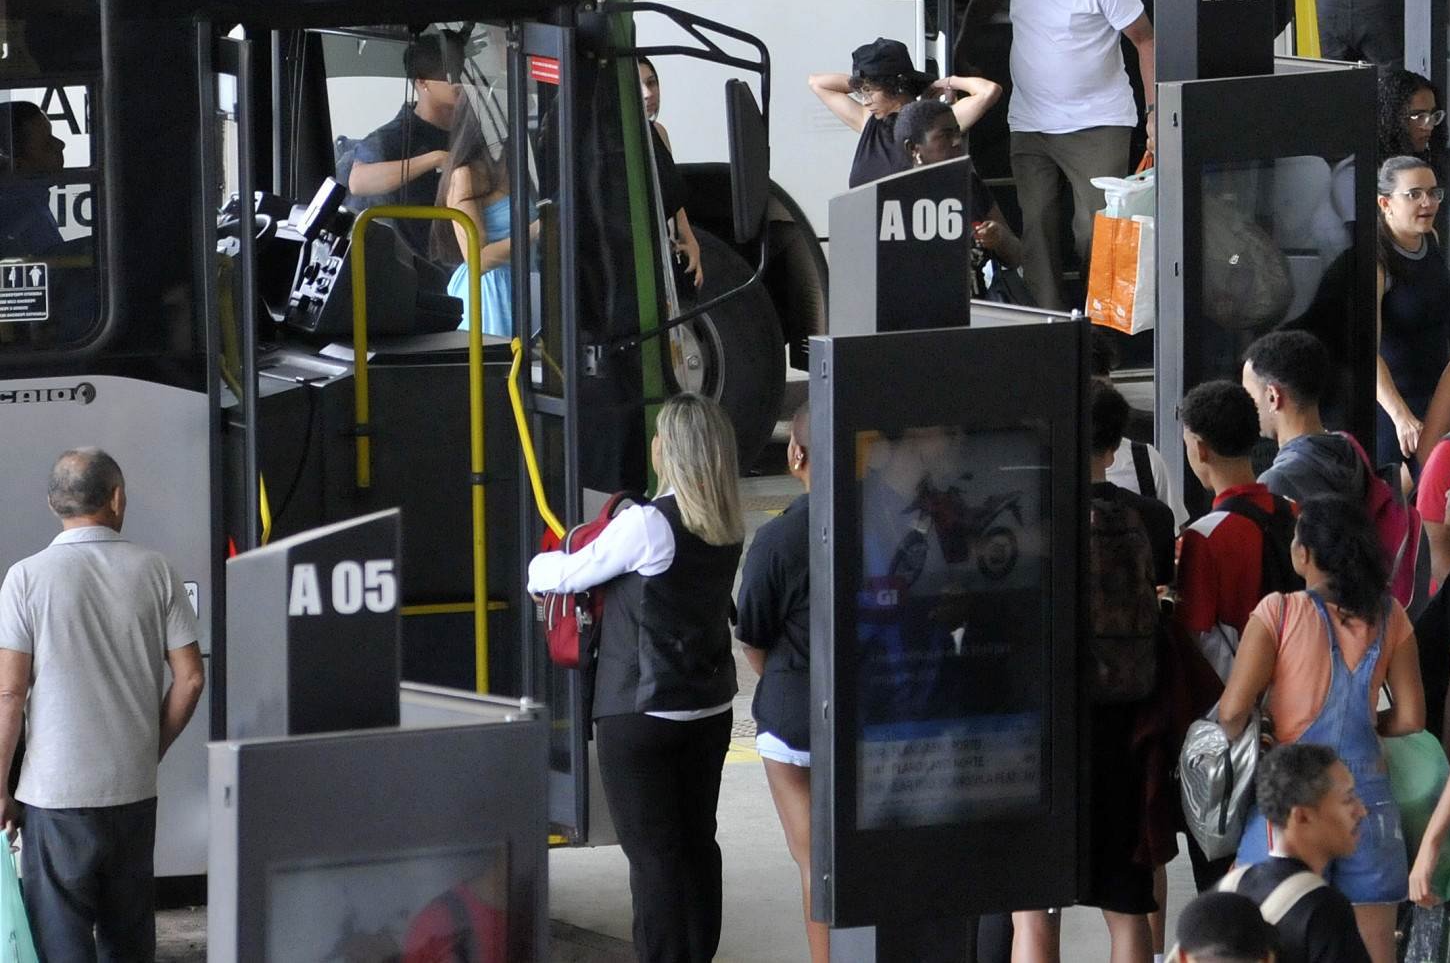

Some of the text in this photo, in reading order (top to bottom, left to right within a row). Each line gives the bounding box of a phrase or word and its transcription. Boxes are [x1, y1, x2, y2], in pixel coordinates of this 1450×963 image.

[879, 197, 963, 241] A 06
[289, 558, 398, 616] A 05
